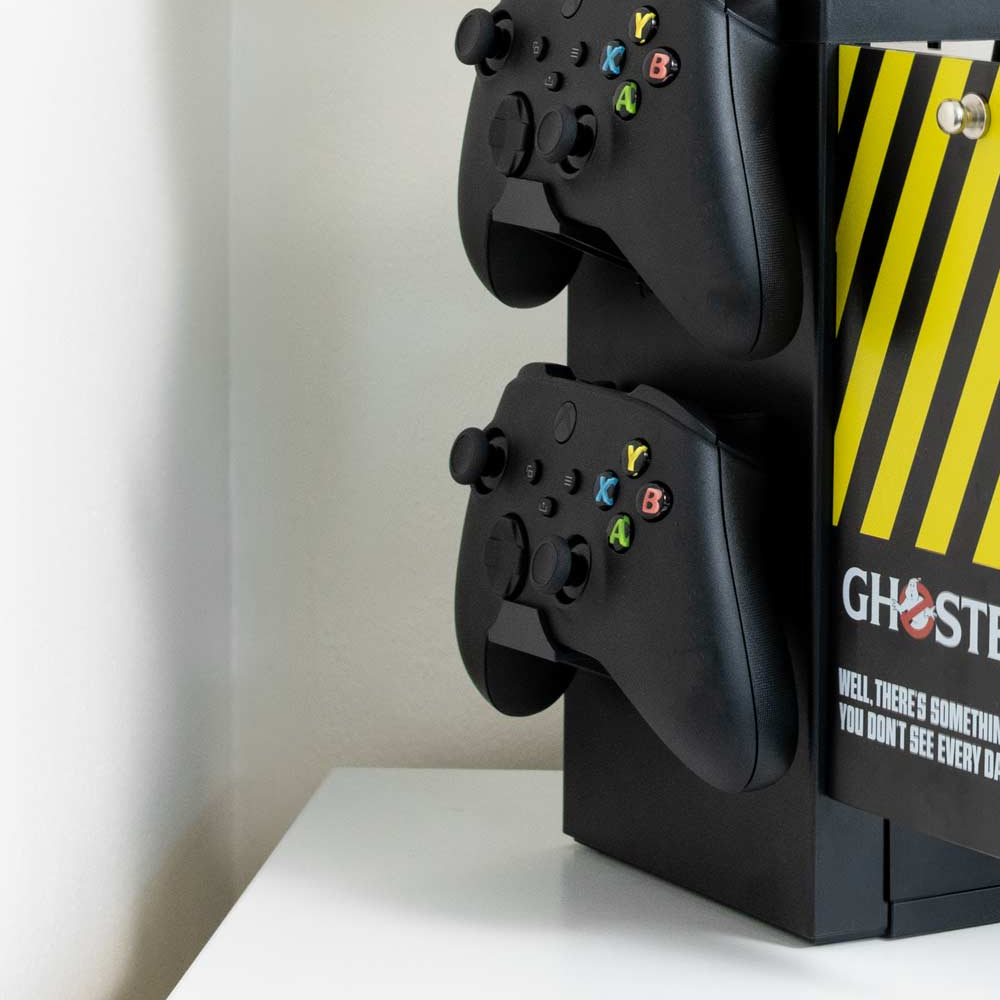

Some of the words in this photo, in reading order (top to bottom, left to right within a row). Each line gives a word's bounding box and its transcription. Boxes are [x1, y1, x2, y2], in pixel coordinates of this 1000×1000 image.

[635, 12, 656, 39] Y
[602, 45, 625, 74] X
[649, 52, 671, 80] B
[615, 82, 637, 114] A
[627, 444, 648, 472] Y
[595, 476, 619, 506] X
[642, 487, 663, 515] B
[609, 515, 631, 548] A
[838, 667, 874, 706] WELL,
[875, 678, 927, 721] THERE'S
[839, 702, 864, 736] YOU
[867, 711, 907, 750] DON'T
[909, 725, 934, 760] SEE
[937, 733, 982, 775] EVERY
